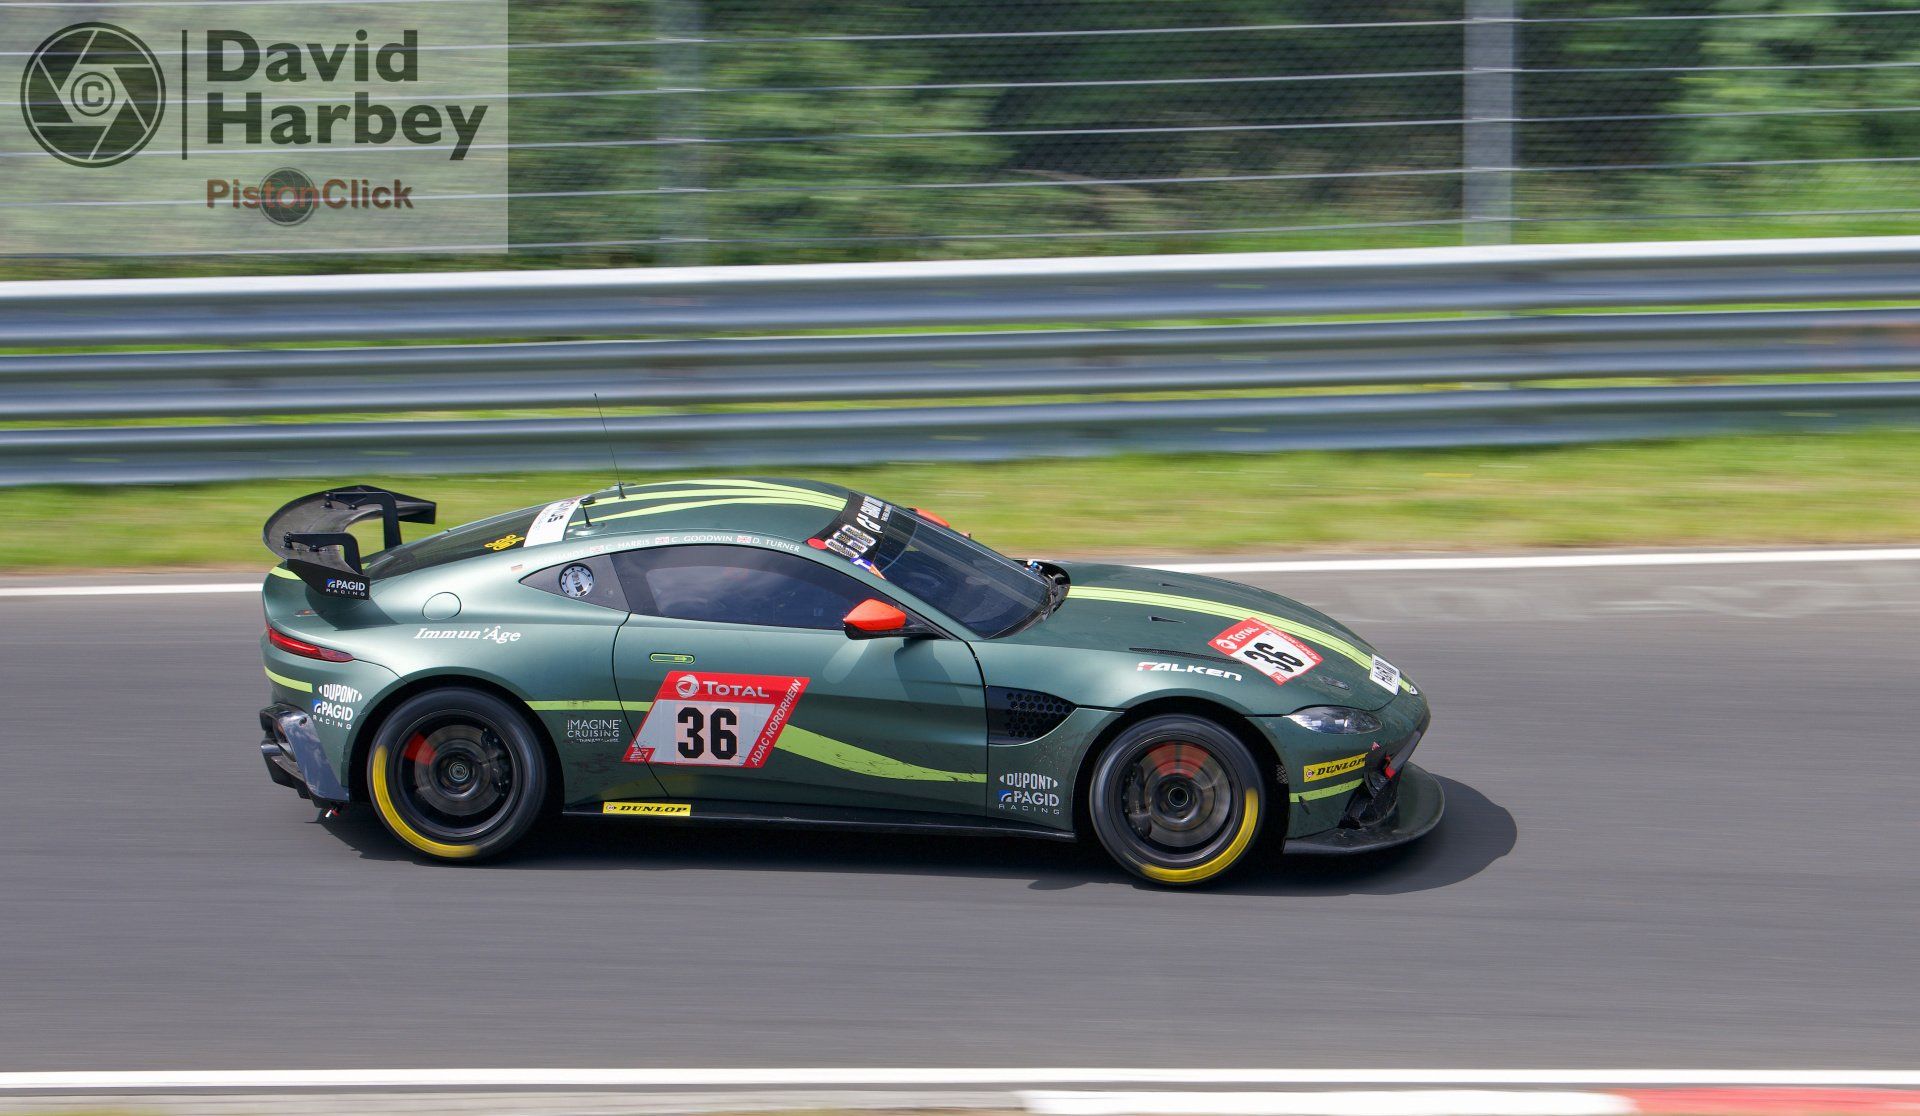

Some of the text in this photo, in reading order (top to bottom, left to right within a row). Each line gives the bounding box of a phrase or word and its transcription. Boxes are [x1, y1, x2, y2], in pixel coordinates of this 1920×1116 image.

[617, 539, 650, 549] HARRIS
[752, 537, 800, 553] D. TURNER
[326, 588, 365, 597] RACING
[336, 579, 366, 591] PAGID
[1227, 625, 1260, 643] TOTAL
[1243, 642, 1305, 673] 36
[1136, 661, 1242, 682] FALKEN
[323, 683, 359, 703] DUPONT
[703, 680, 770, 699] TOTAL
[321, 700, 354, 722] PAGID
[312, 714, 352, 730] RACING
[567, 719, 621, 730] IMAGINE
[751, 678, 803, 767] ADAC NORDRHEIN
[567, 730, 620, 738] CRUISING
[676, 706, 738, 761] 36
[1316, 757, 1366, 776] DUNLOP
[1006, 772, 1053, 790] DUPONT
[1013, 790, 1060, 807] PAGID
[619, 805, 687, 813] DUNLOP
[998, 803, 1060, 815] RACING
